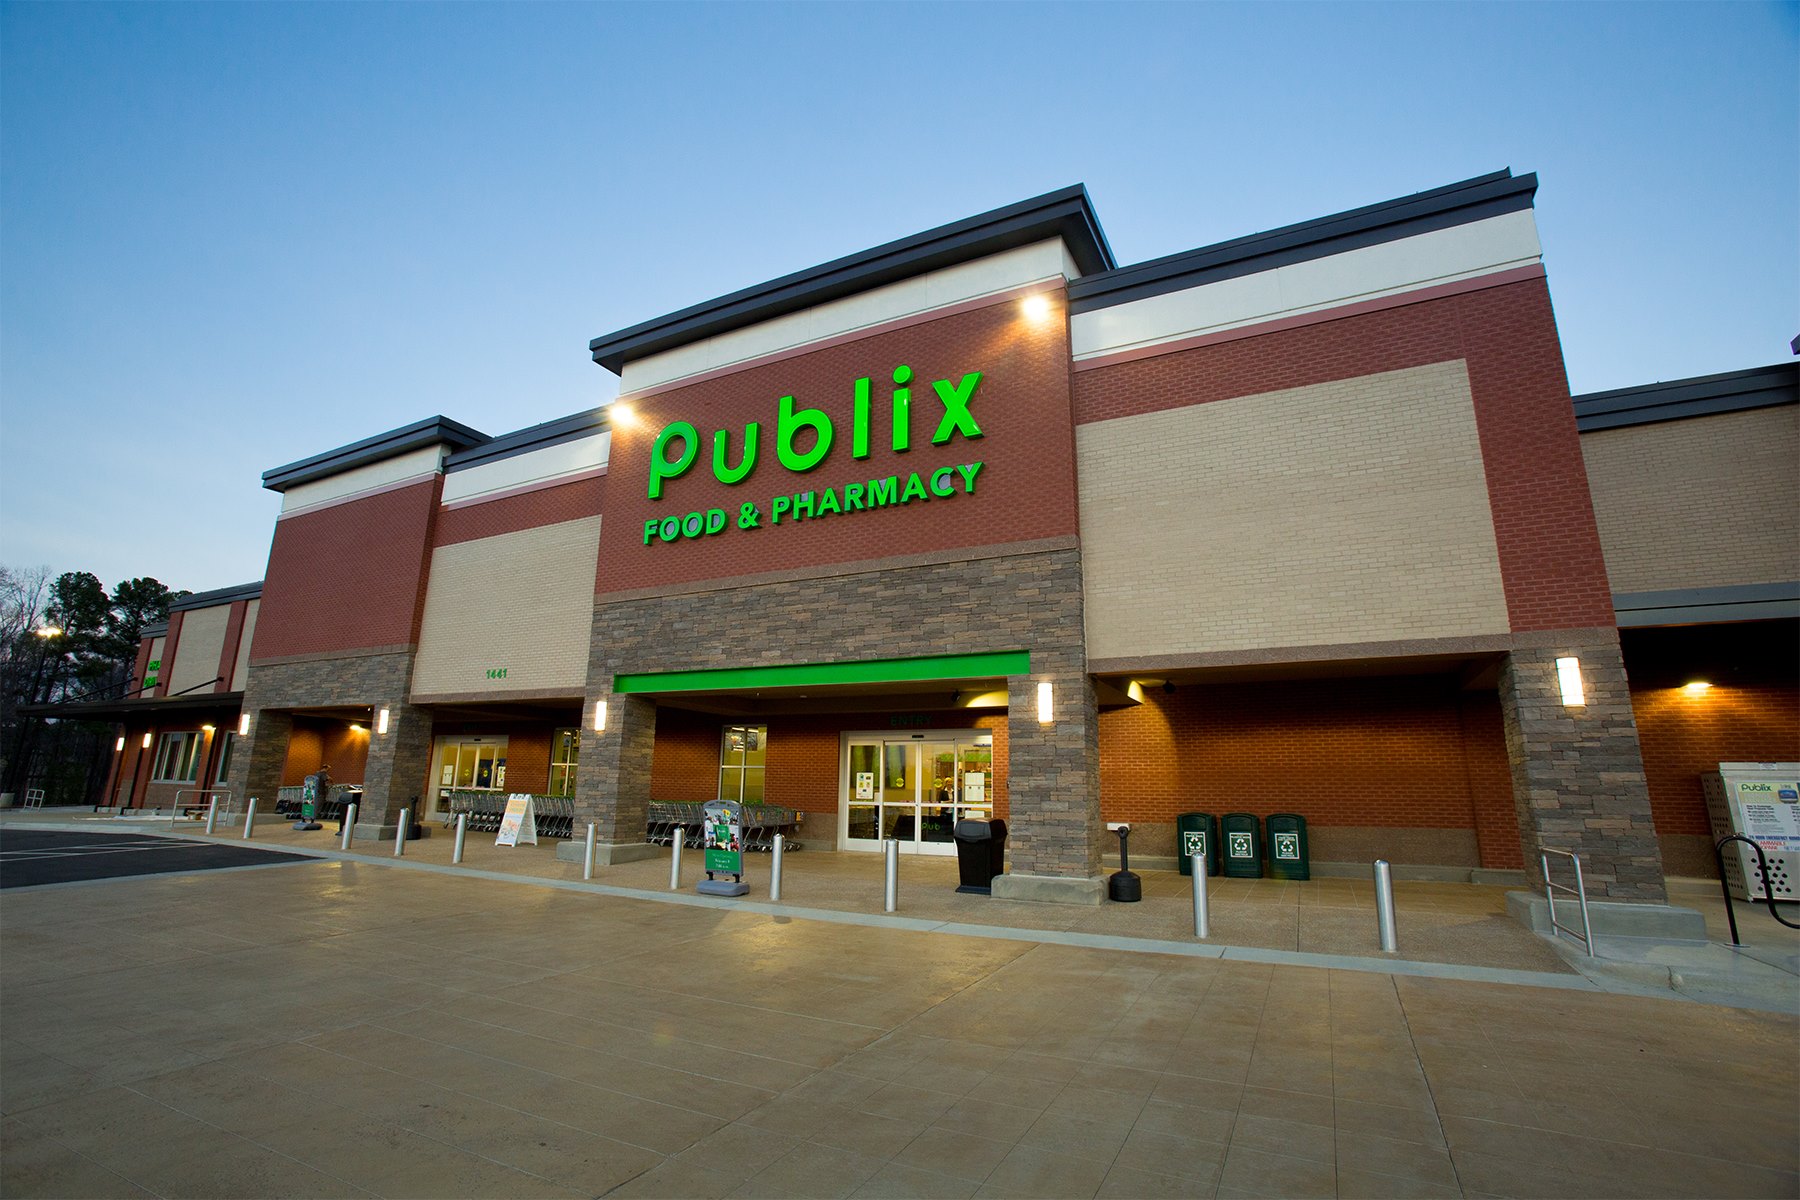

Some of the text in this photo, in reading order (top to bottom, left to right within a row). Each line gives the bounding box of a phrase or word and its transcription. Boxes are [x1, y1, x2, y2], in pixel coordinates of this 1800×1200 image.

[643, 461, 985, 545] FOOD & PHARMACY
[486, 668, 508, 680] 1441
[1741, 783, 1773, 792] Publix
